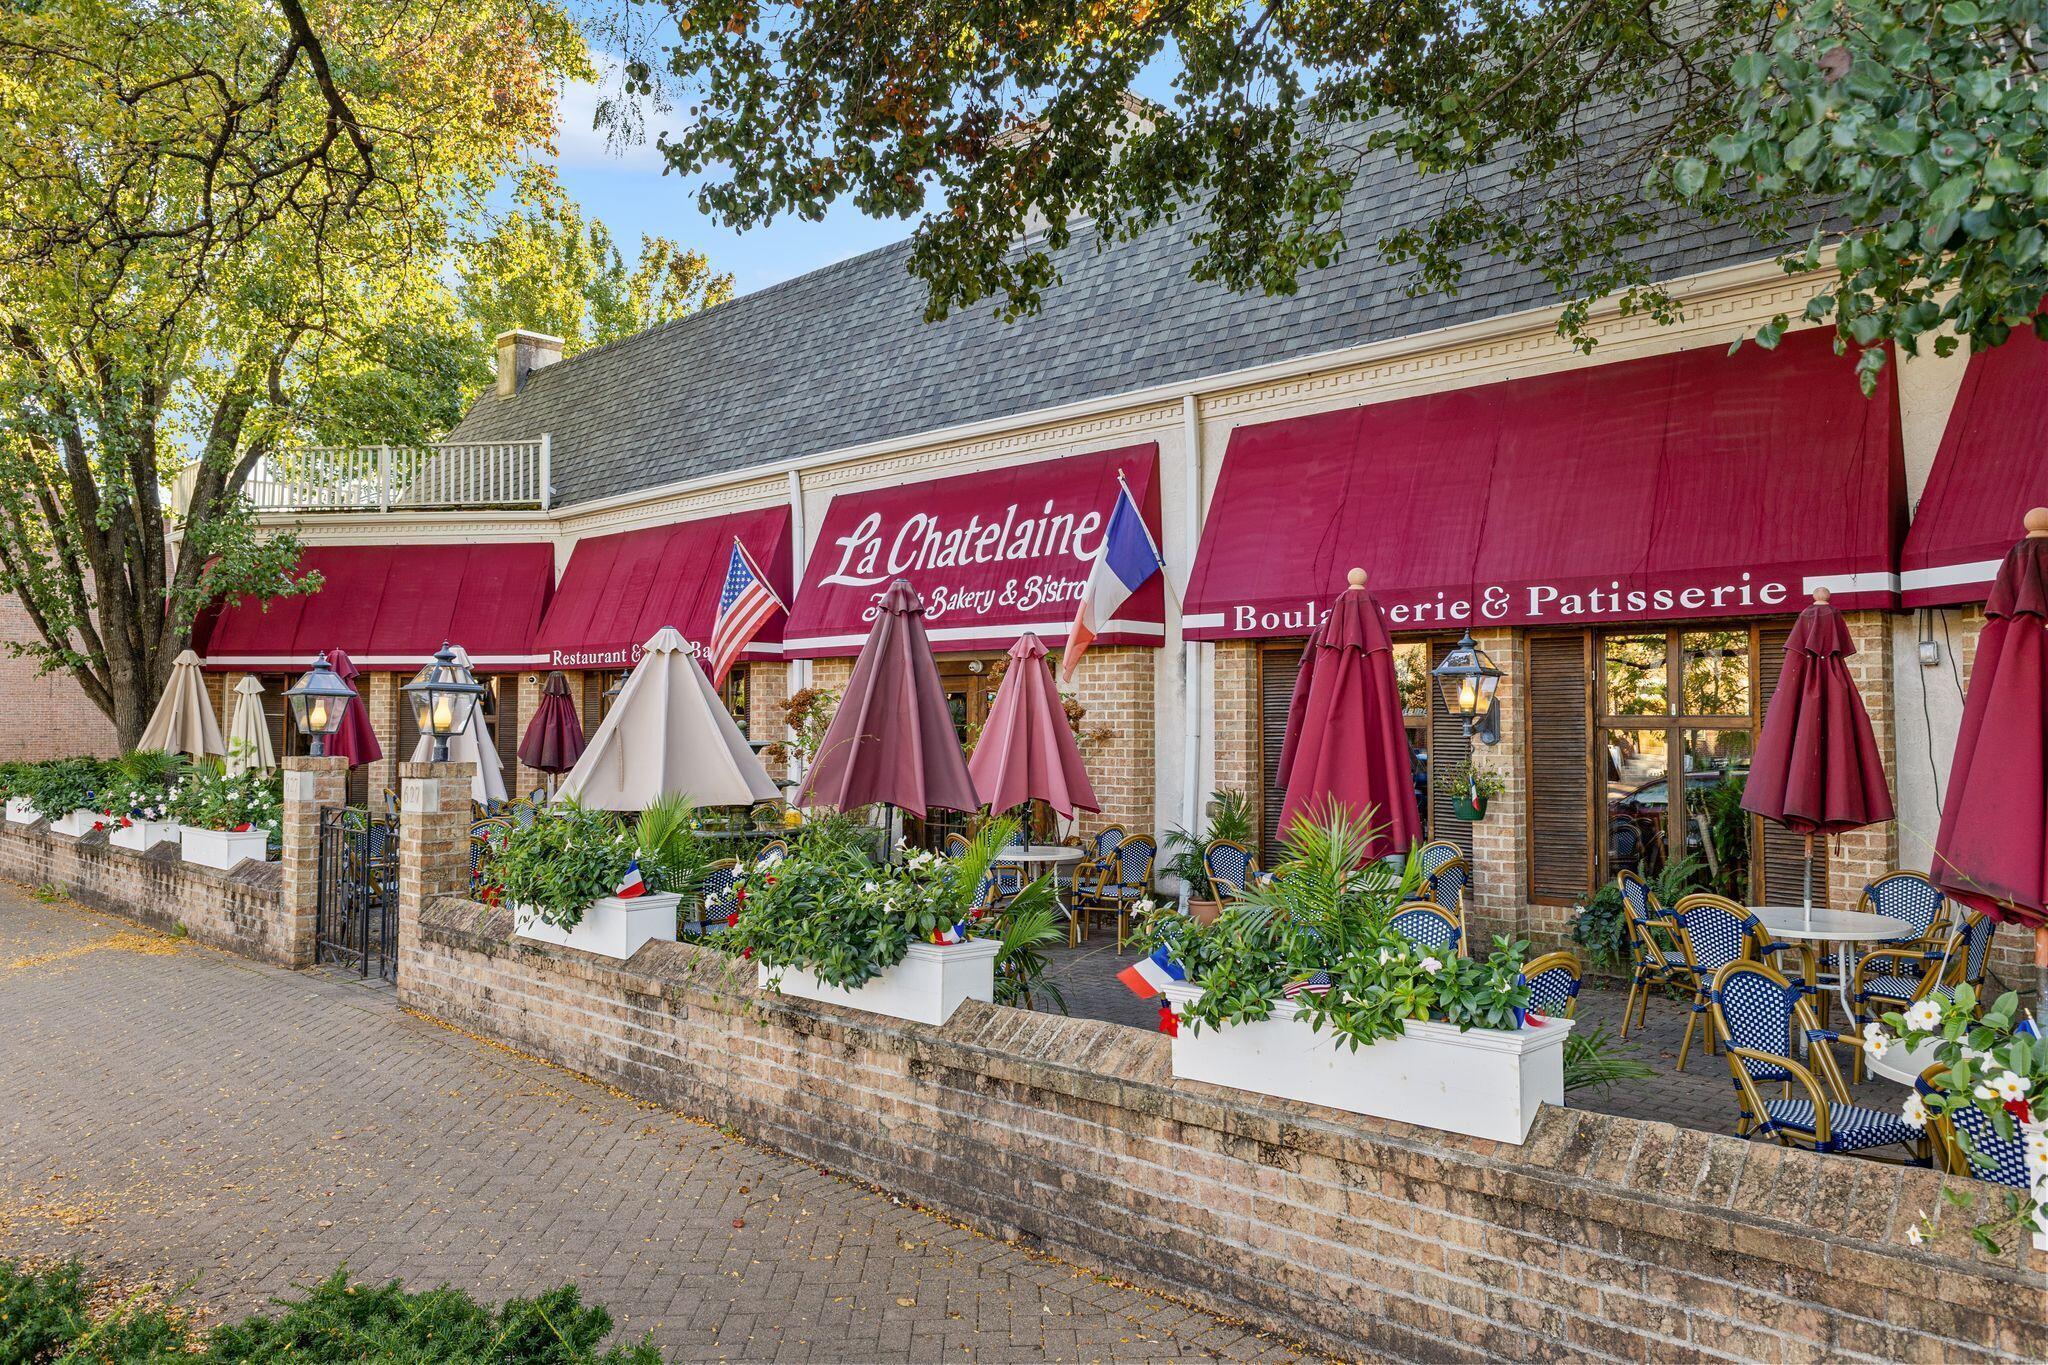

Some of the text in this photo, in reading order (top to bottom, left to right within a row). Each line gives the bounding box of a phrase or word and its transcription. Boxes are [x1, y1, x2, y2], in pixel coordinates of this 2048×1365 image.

[818, 499, 1101, 588] La Chatelaine
[924, 586, 996, 620] Bakery
[998, 579, 1018, 606] &
[1017, 574, 1087, 611] Bistro
[1233, 572, 1787, 631] Boulerie & Patisserie
[552, 641, 711, 666] Restaurant & Ba
[403, 785, 420, 804] 627
